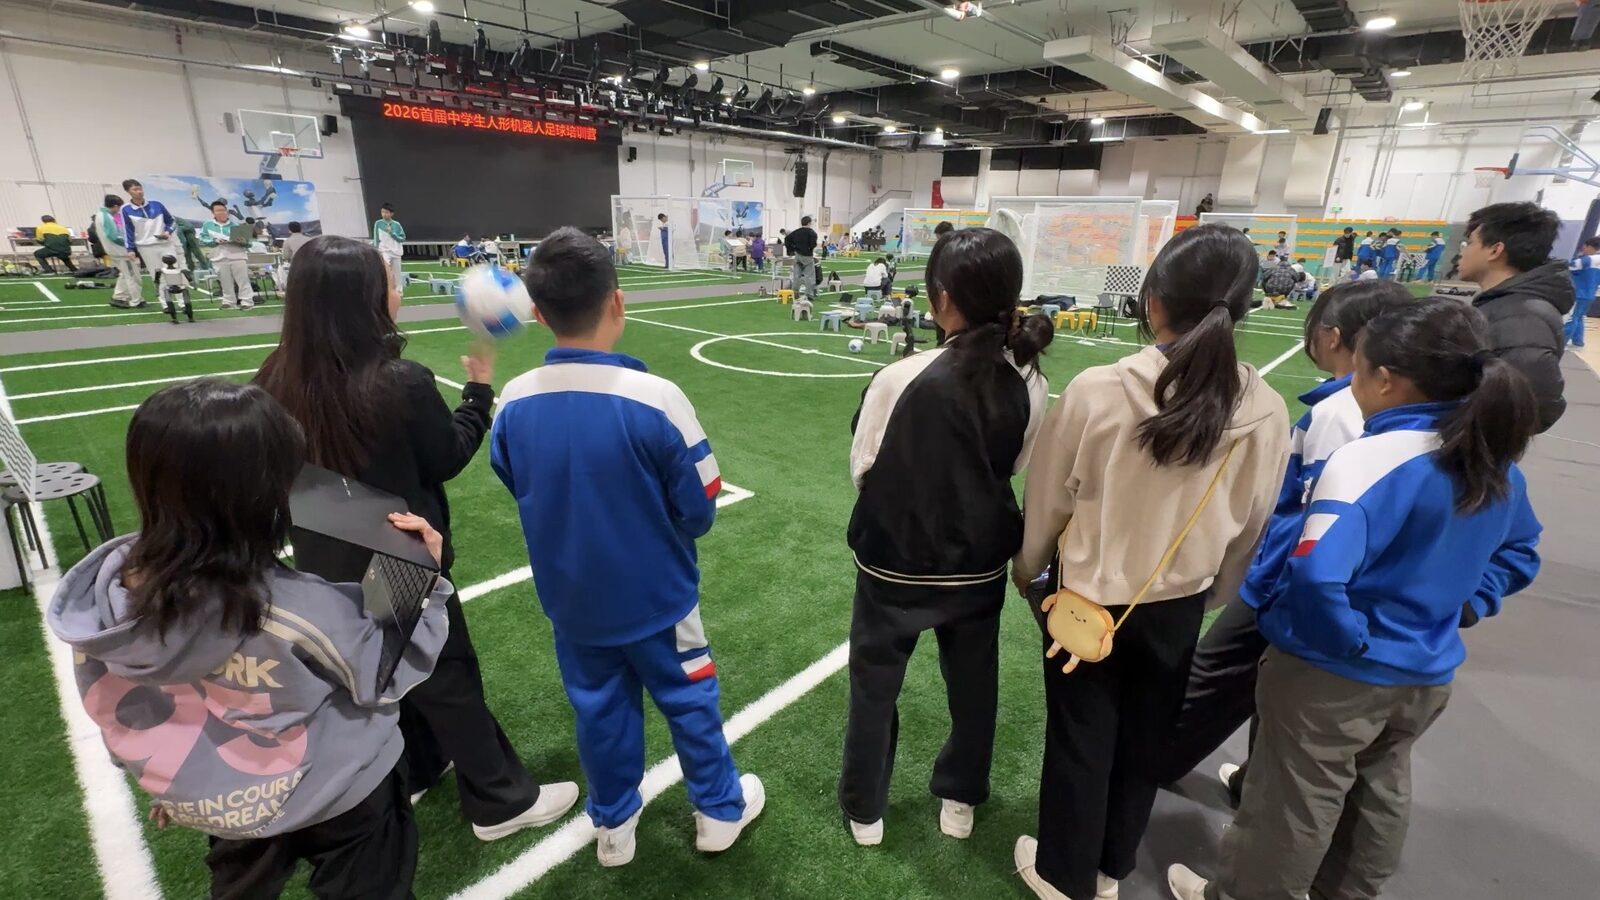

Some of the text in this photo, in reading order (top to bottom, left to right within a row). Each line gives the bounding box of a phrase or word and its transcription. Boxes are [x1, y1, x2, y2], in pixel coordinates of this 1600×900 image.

[383, 102, 597, 141] 2026首届中学生人形机器人足球培训营
[211, 652, 284, 688] RK
